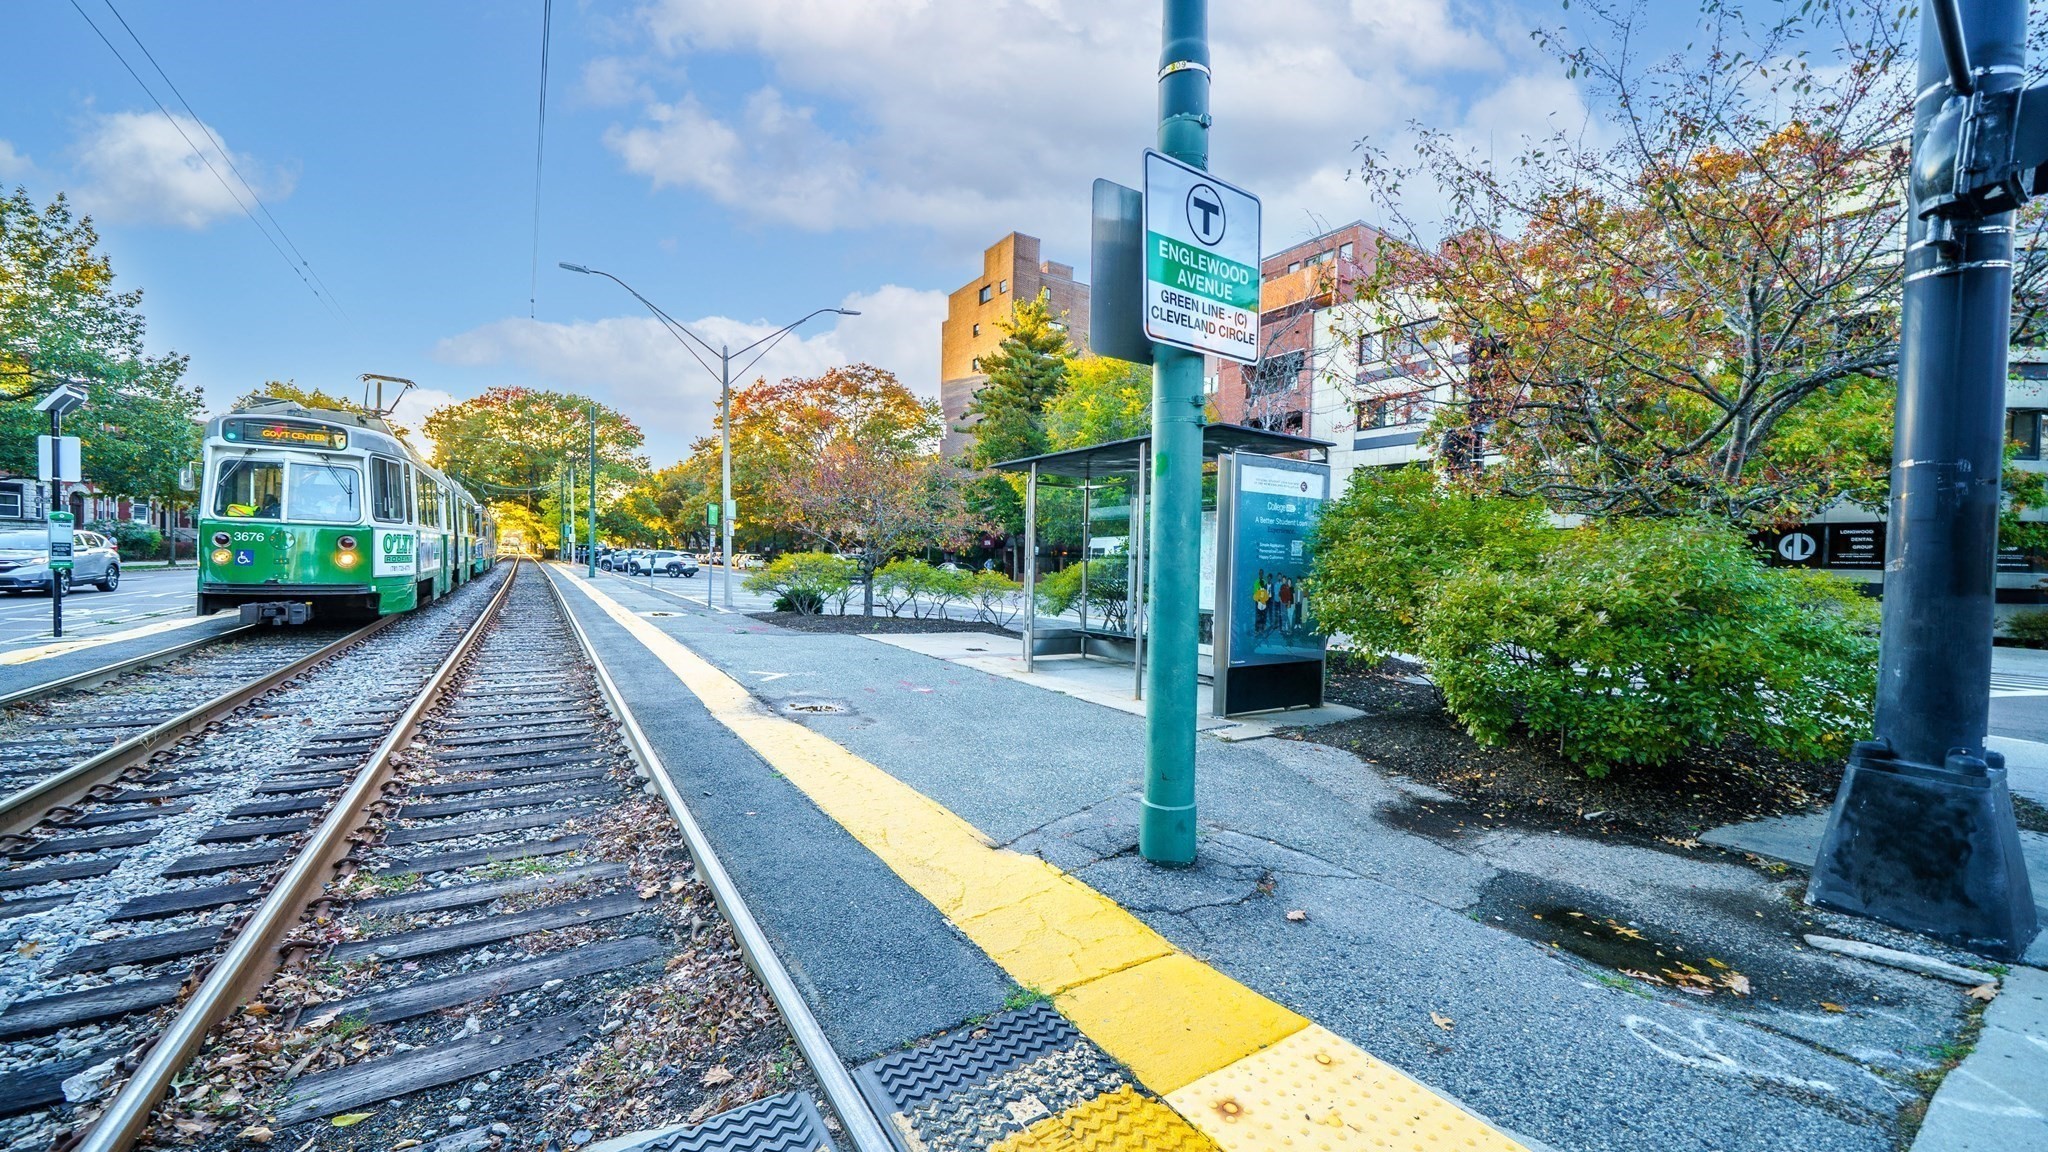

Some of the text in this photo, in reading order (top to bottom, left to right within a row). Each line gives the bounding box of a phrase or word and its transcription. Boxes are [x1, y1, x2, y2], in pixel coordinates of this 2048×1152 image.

[1193, 196, 1220, 236] T
[1159, 239, 1249, 286] ENGLEWOOD
[1177, 269, 1233, 301] AVENUE
[1151, 305, 1255, 346] CLEVELAND CIRCLE
[1161, 290, 1199, 313] GREEN
[1202, 301, 1225, 321] LINE
[1234, 311, 1248, 329] (C)
[291, 432, 326, 442] CENTER
[1260, 517, 1275, 525] Better
[1275, 517, 1296, 526] Student
[1297, 519, 1307, 527] Loan
[1267, 502, 1286, 513] College
[233, 531, 265, 542] 3676
